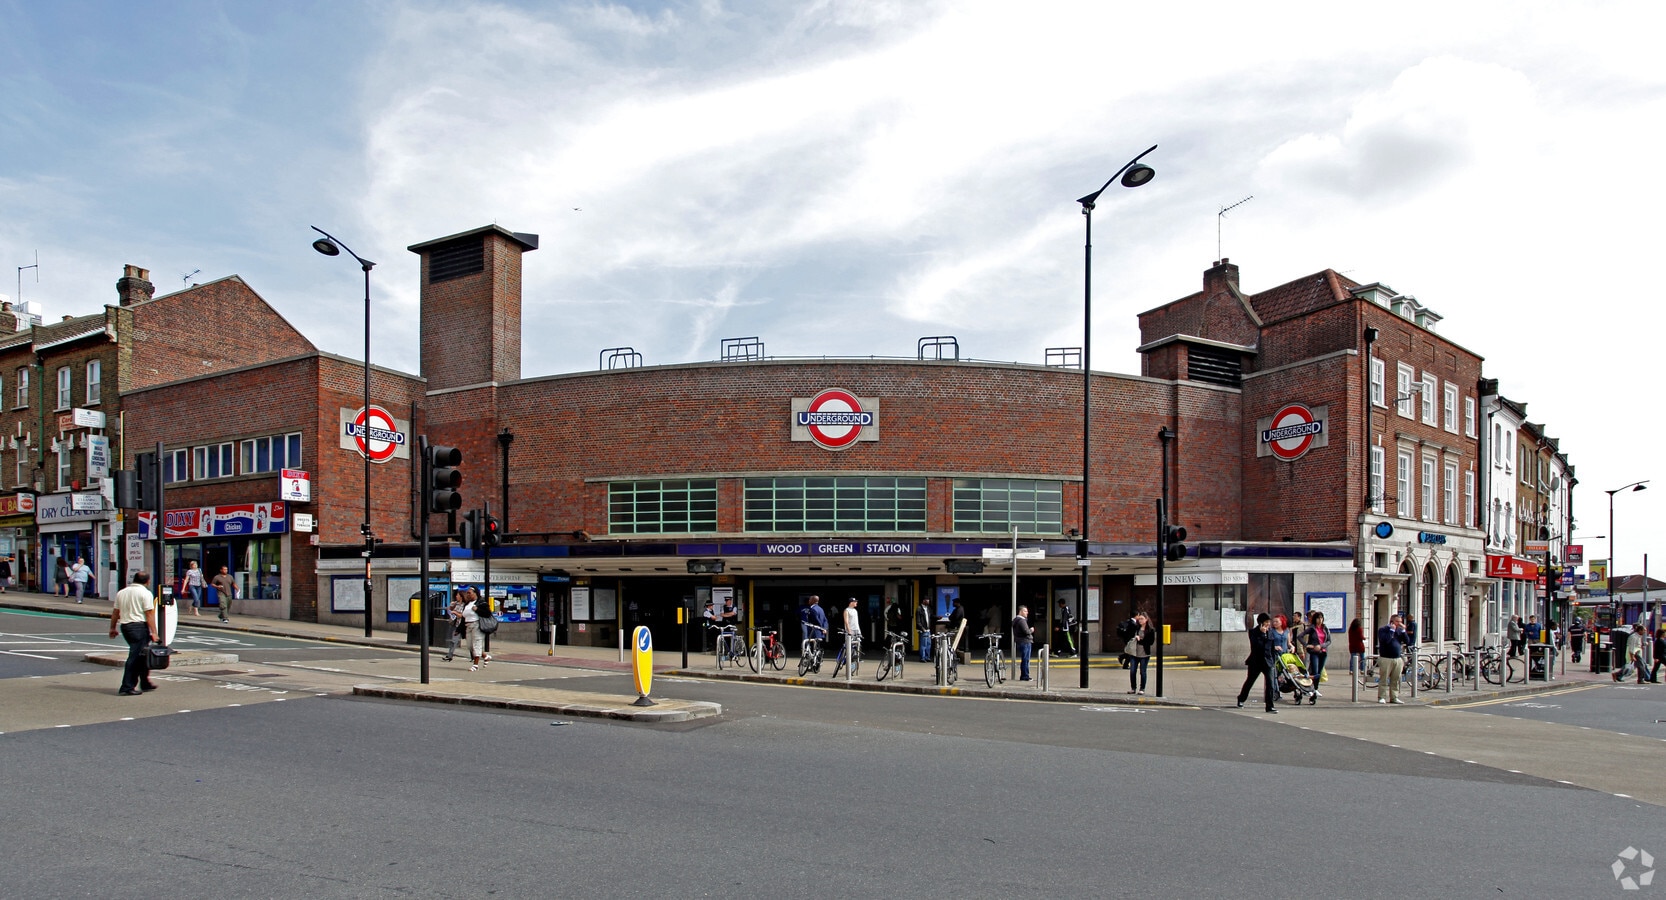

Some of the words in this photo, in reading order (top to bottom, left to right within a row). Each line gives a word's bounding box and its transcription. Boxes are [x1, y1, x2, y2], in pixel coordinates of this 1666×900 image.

[799, 412, 871, 425] UNDERGROUND
[347, 423, 404, 444] UNDRGROUND
[1263, 421, 1321, 442] UNDERGROUND
[42, 508, 57, 519] DRY
[166, 511, 196, 528] DIXY
[766, 544, 802, 553] WOOD
[818, 543, 853, 553] GREEN
[866, 543, 911, 553] STATION
[472, 574, 482, 582] NJ
